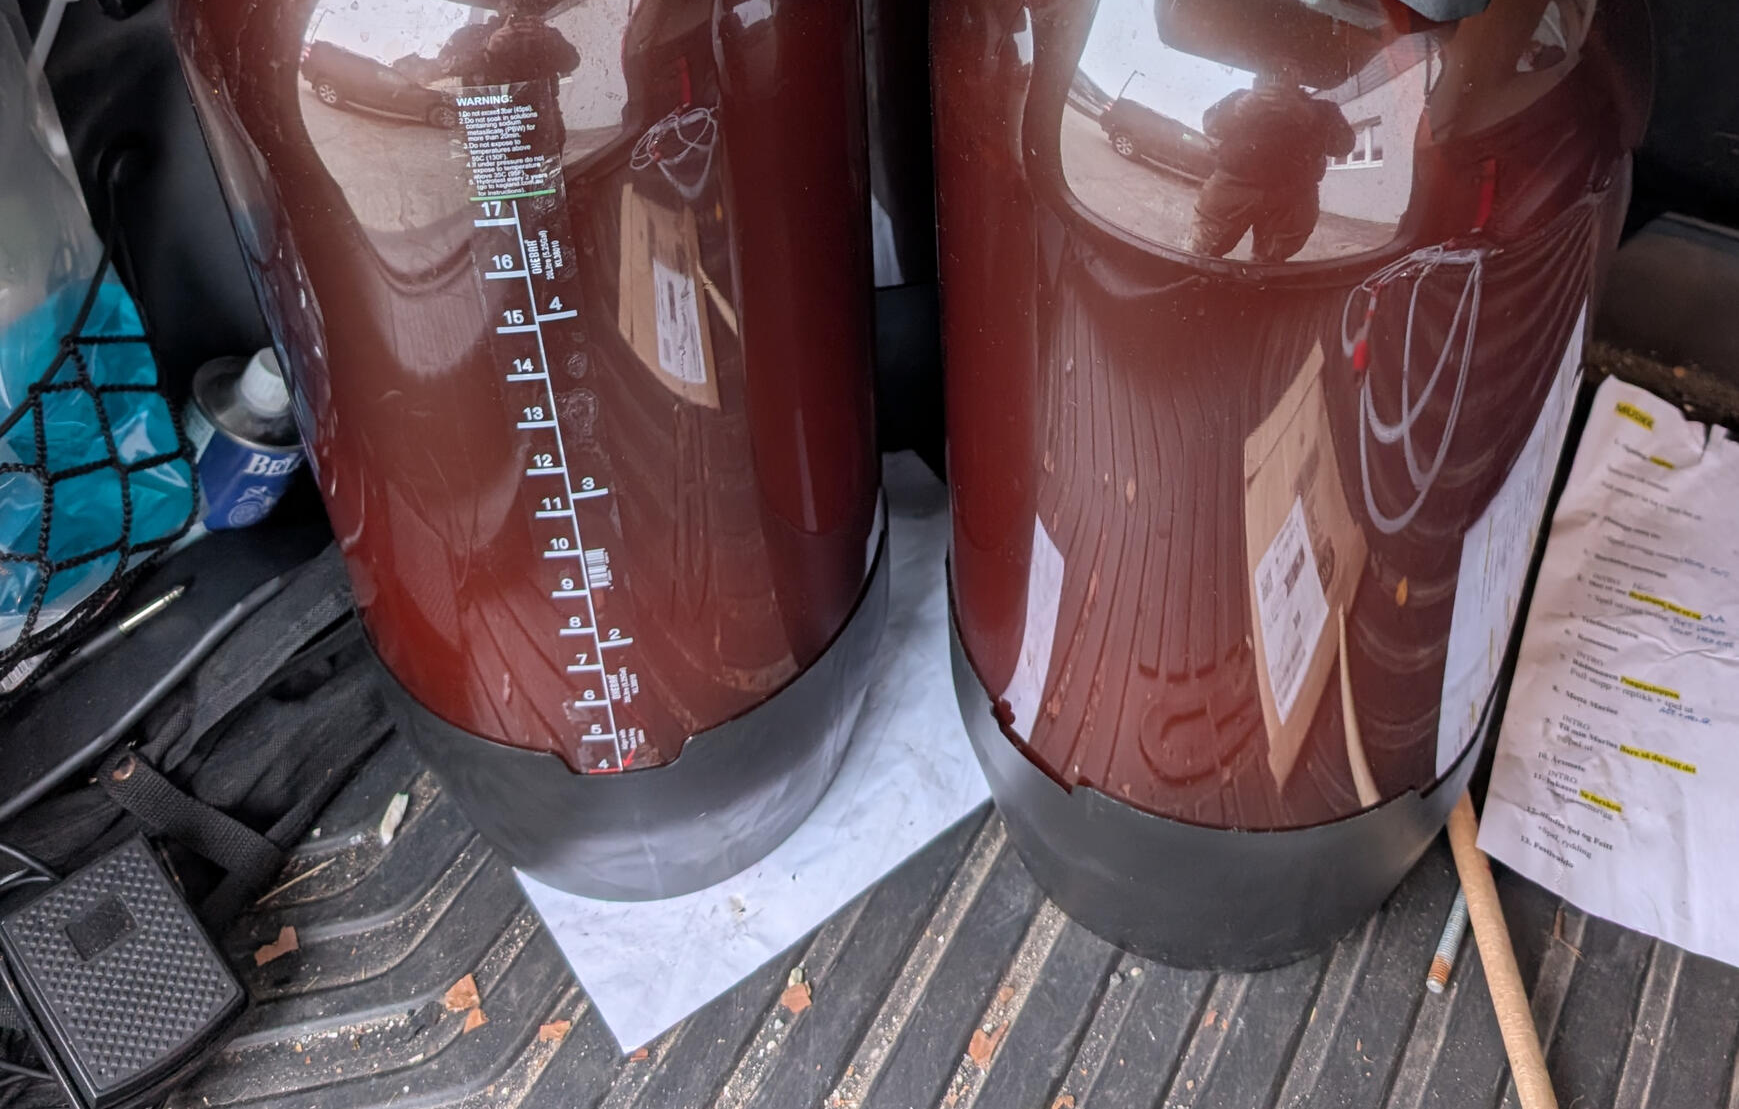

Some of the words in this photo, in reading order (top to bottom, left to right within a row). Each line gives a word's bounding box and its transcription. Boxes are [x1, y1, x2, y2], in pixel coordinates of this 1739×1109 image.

[456, 95, 513, 107] WARNING:
[481, 201, 502, 217] 17
[492, 254, 514, 270] 16
[549, 296, 563, 311] 4
[503, 309, 525, 325] 15
[513, 358, 535, 373] 14
[523, 406, 544, 421] 13
[533, 453, 554, 468] 12
[581, 476, 595, 491] 3
[541, 496, 563, 511] 11
[550, 537, 570, 551] 10
[561, 578, 574, 591] 9
[569, 616, 582, 628] 8
[608, 628, 622, 641] 2
[576, 653, 588, 666] 7
[583, 689, 596, 701] 6
[590, 724, 602, 735] 5
[598, 758, 609, 770] 4
